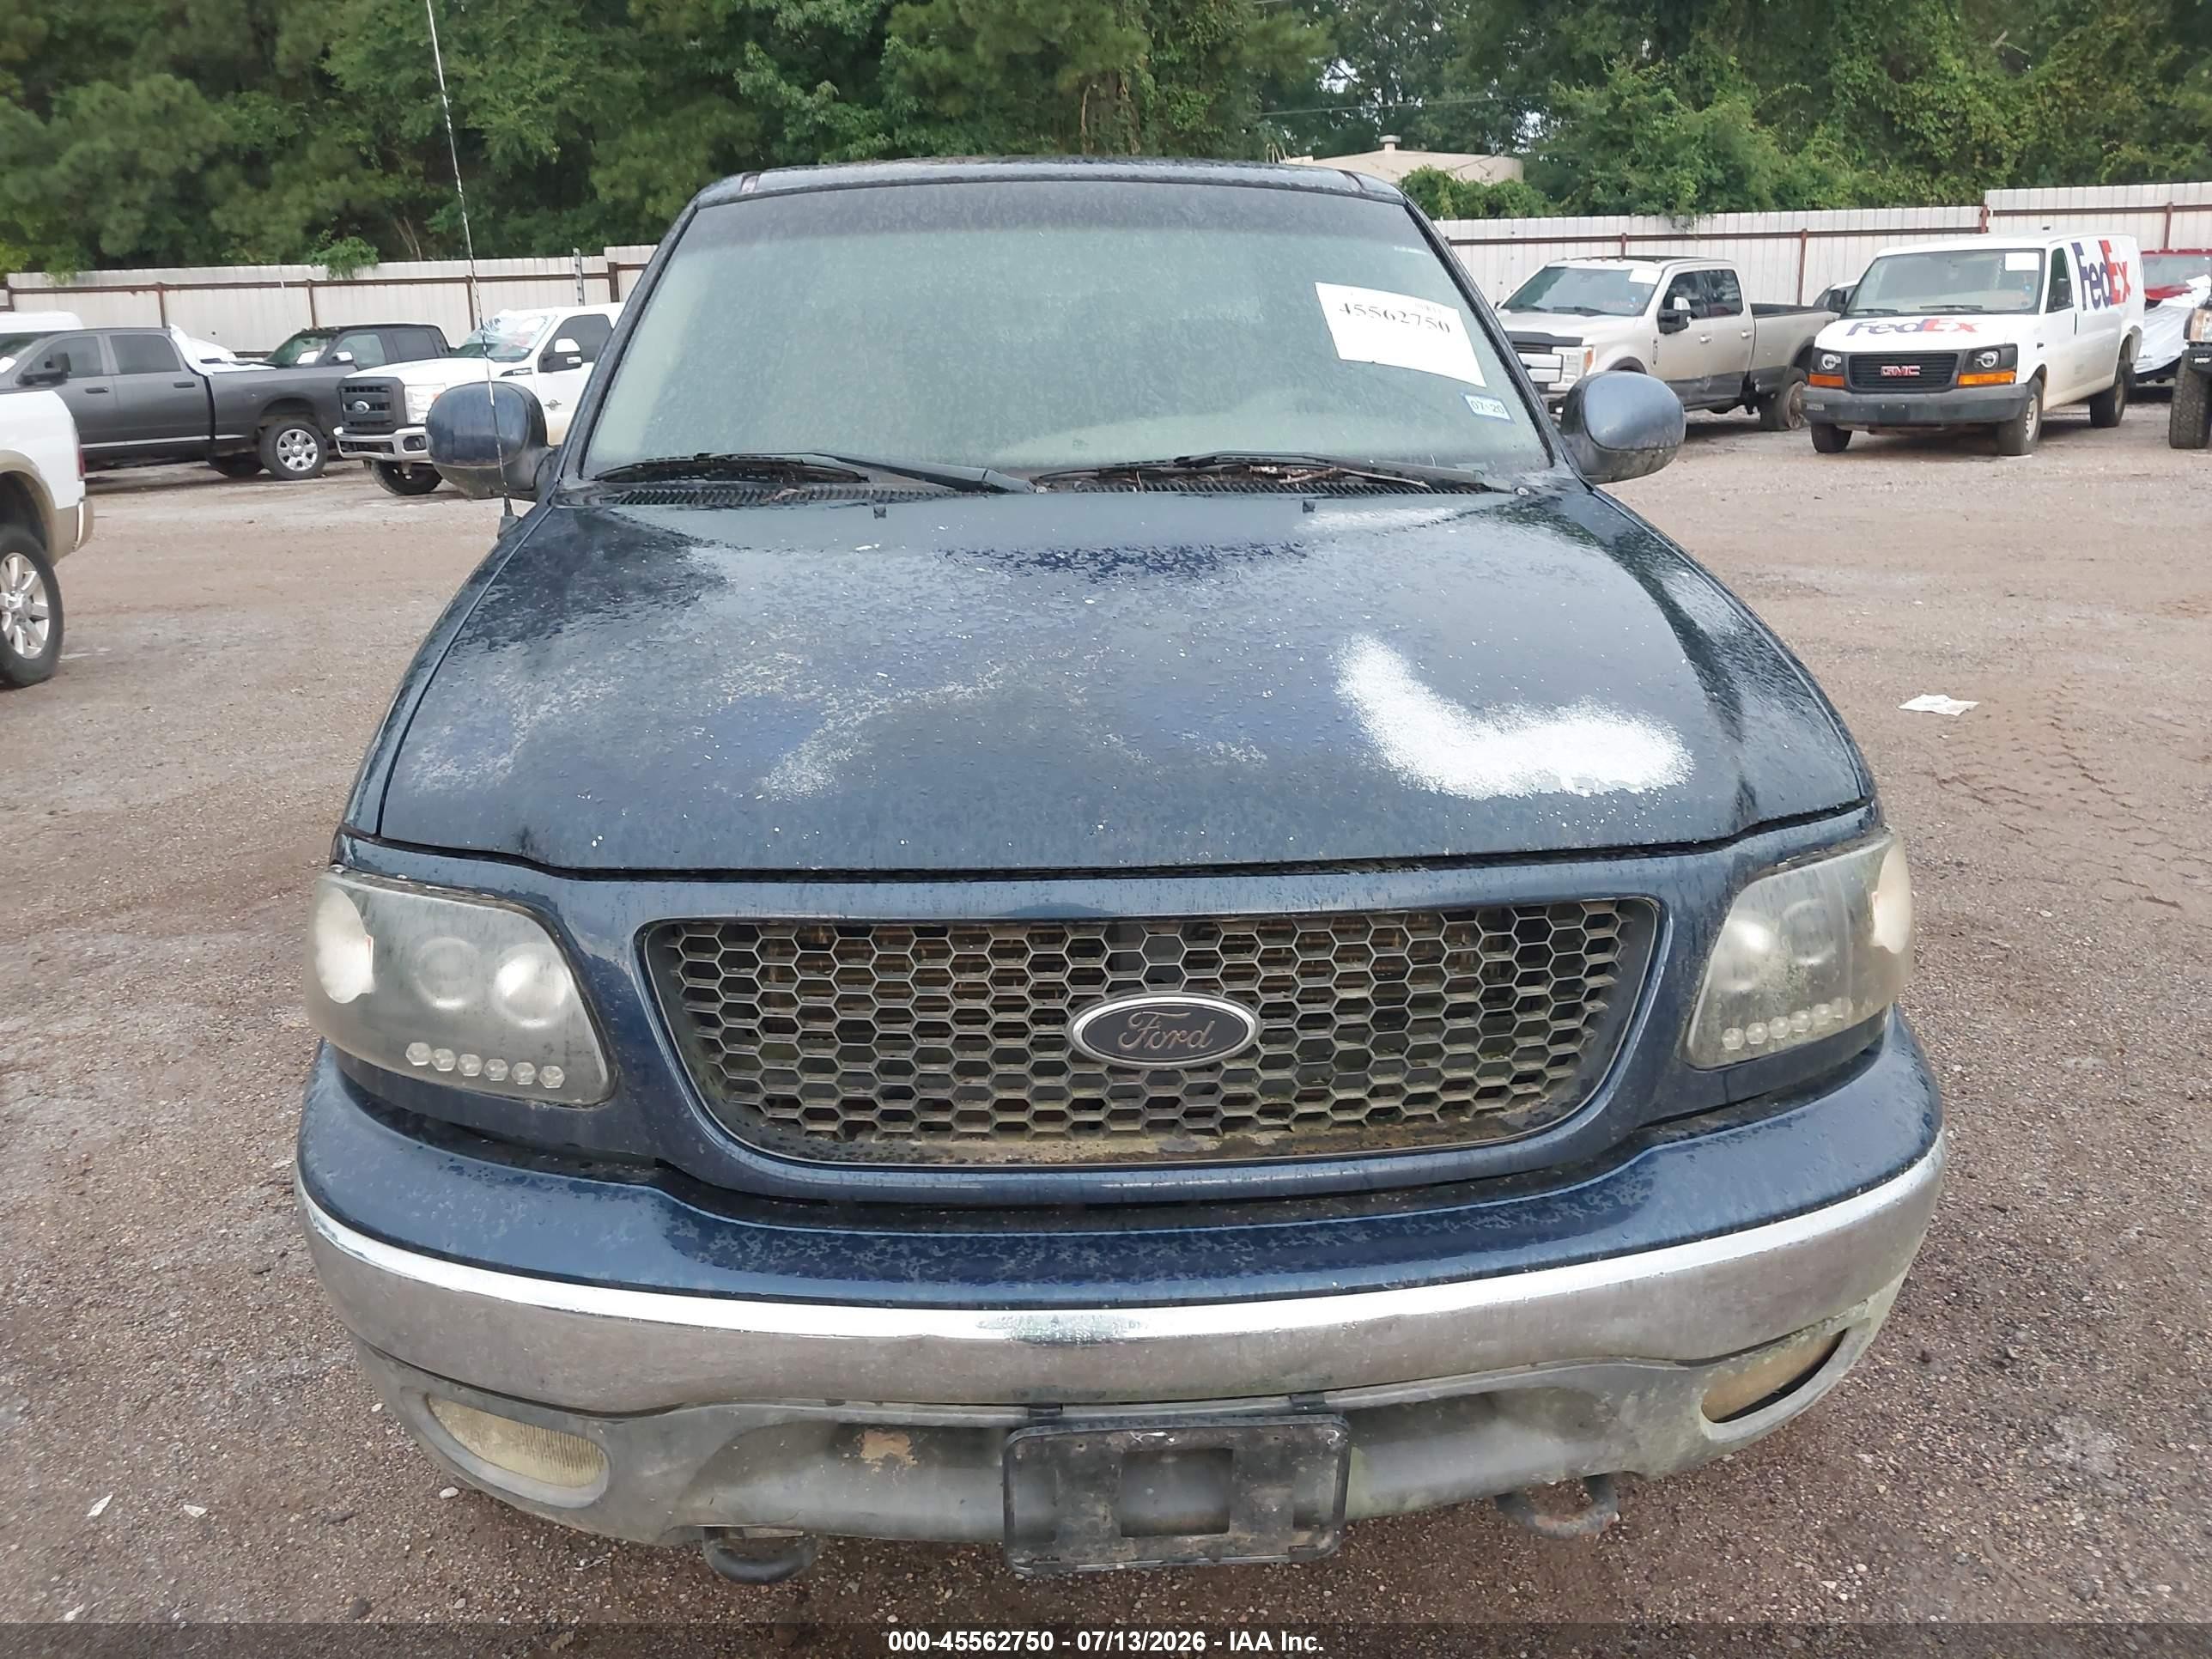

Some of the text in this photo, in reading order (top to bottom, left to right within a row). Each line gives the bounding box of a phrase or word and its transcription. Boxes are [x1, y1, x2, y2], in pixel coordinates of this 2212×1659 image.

[2071, 240, 2130, 310] FedEx
[1339, 302, 1450, 333] 45562750
[1846, 318, 1981, 336] FedEx
[1881, 365, 1921, 376] GMC
[1118, 1011, 1216, 1051] Ford
